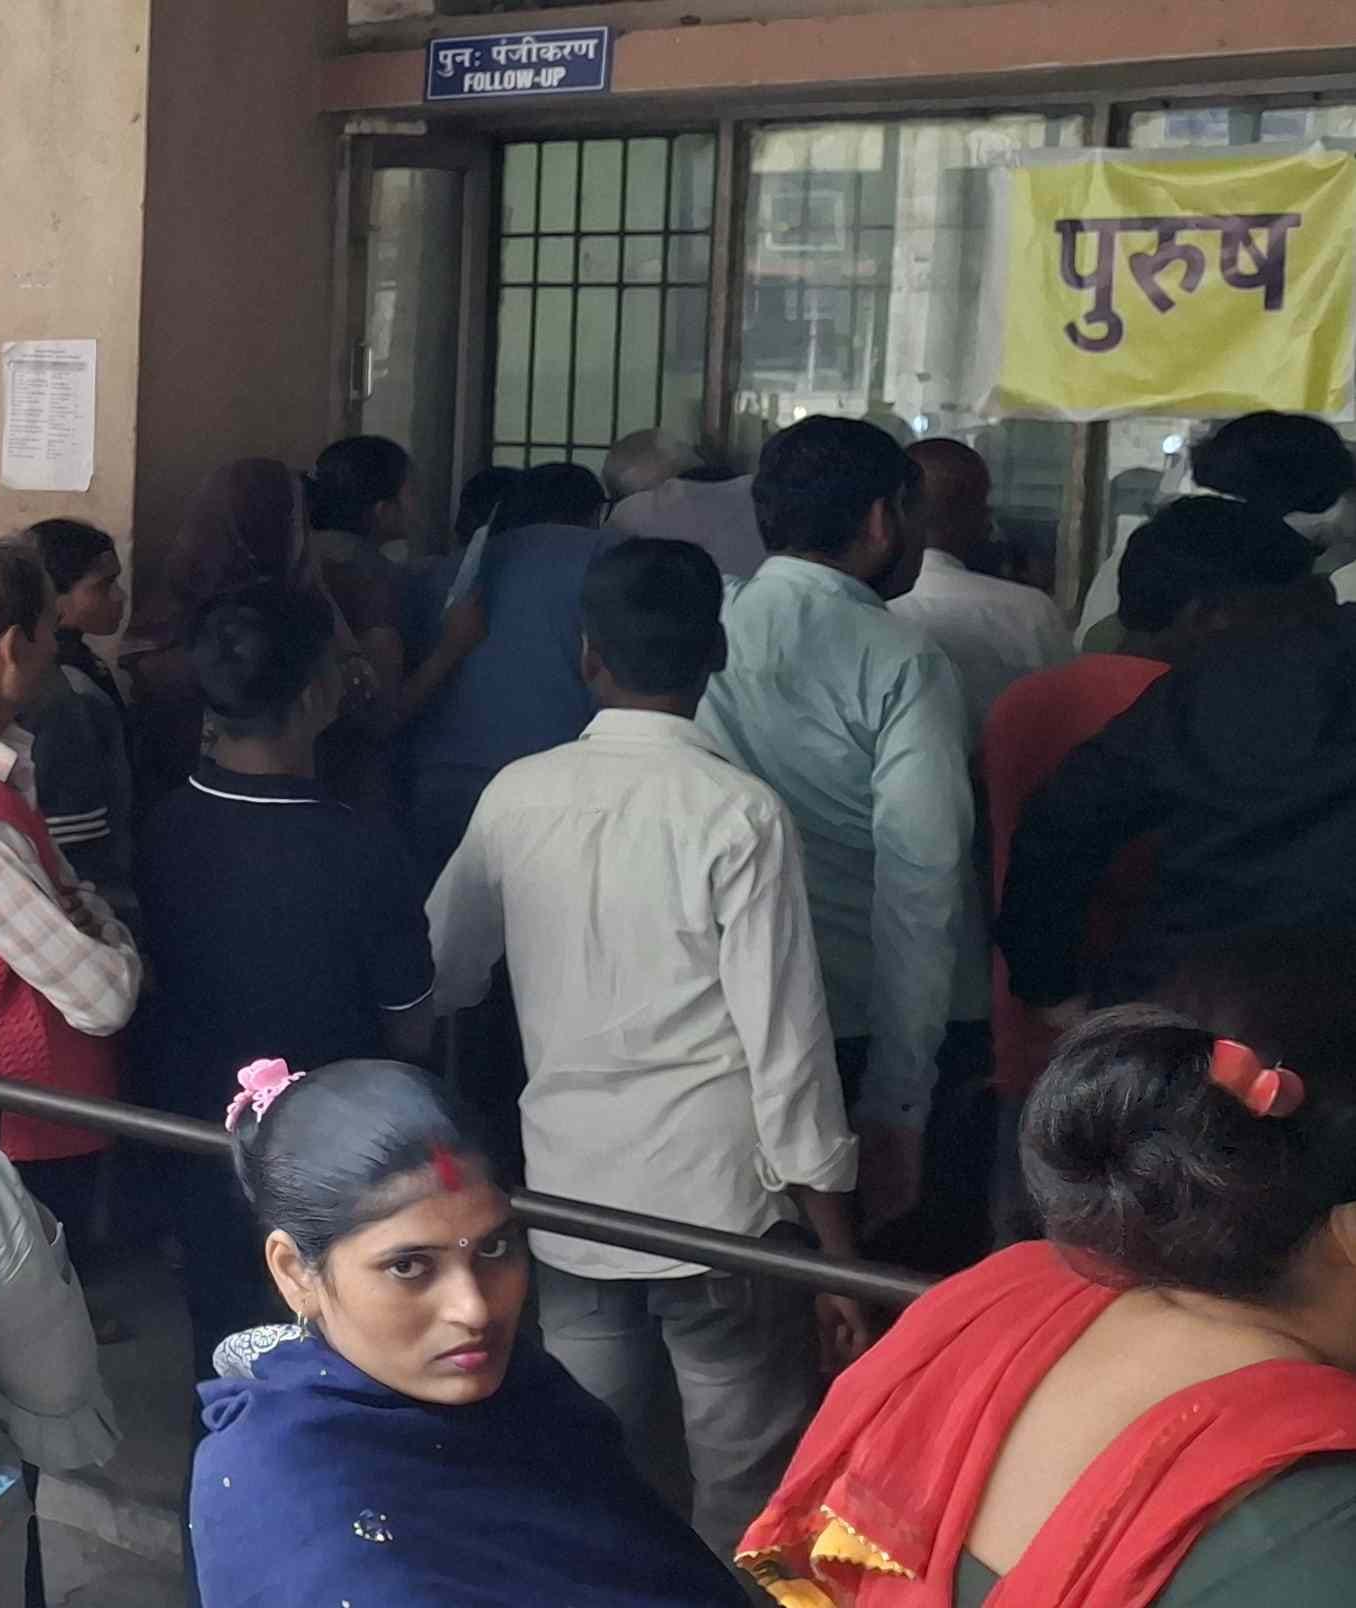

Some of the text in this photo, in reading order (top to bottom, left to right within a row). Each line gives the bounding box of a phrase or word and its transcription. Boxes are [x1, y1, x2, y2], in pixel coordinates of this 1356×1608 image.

[438, 36, 598, 77] पुनः पंजीकरण
[463, 66, 567, 92] FOLLOW-UP
[1054, 213, 1302, 353] पुरुष
